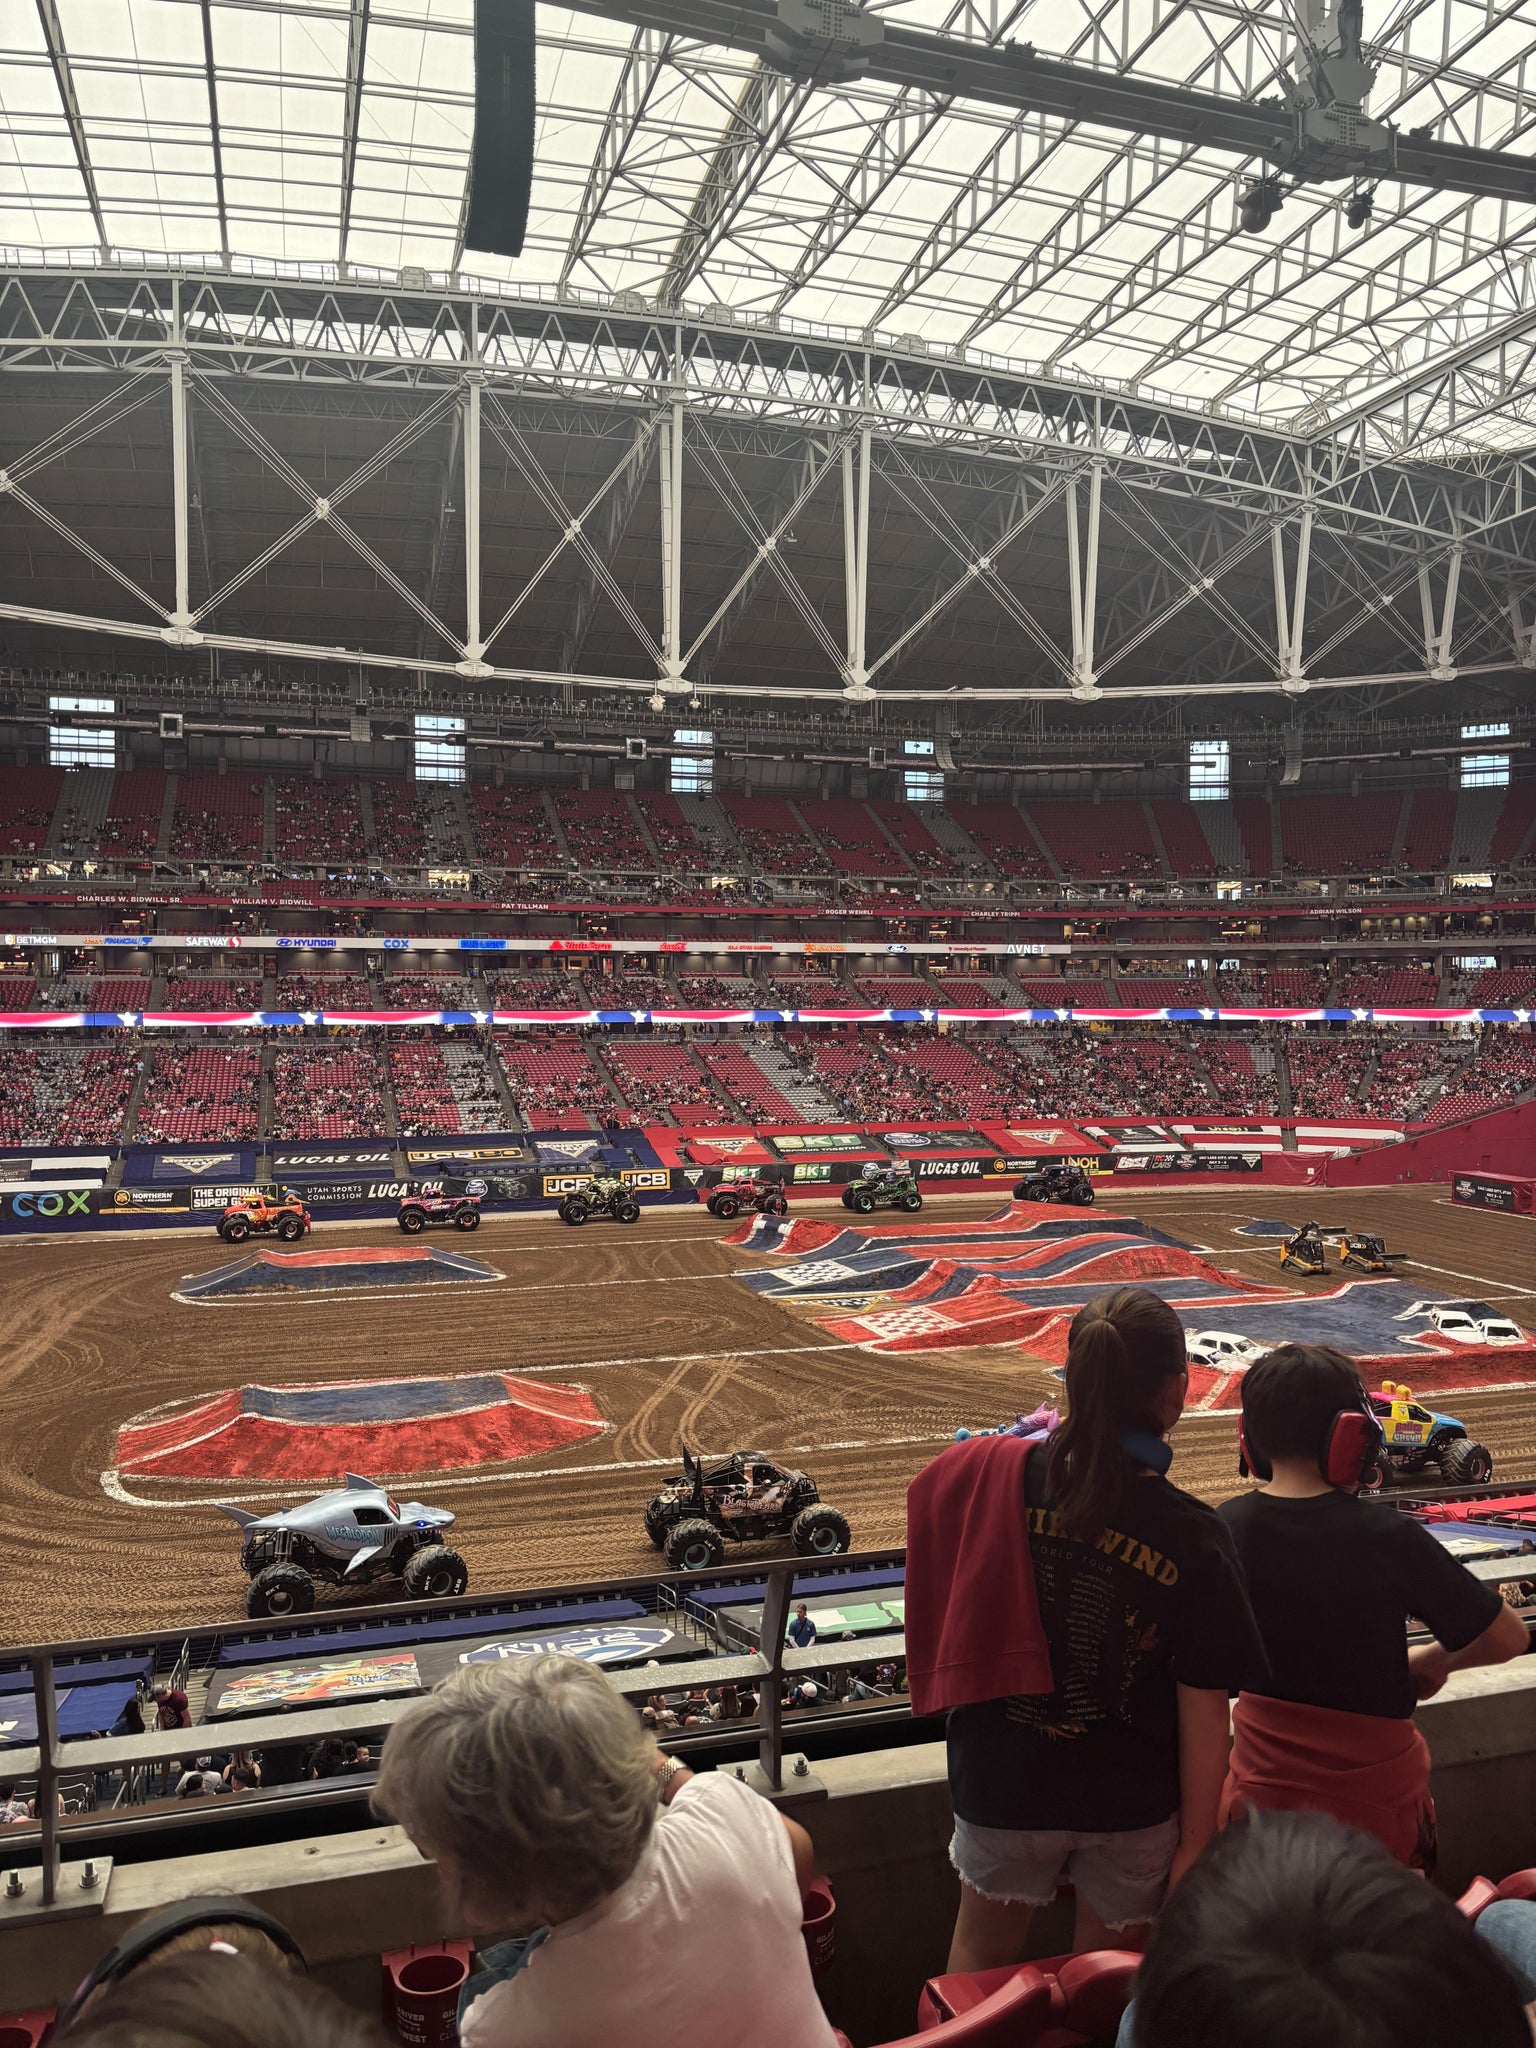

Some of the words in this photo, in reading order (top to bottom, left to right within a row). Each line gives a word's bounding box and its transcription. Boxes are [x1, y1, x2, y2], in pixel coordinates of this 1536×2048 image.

[130, 896, 168, 904] BIDWILL,
[185, 937, 230, 946] SAFEWAY
[293, 939, 337, 947] HYUNDAI
[383, 939, 409, 949] COX
[1007, 944, 1047, 954] AVNET
[776, 1135, 857, 1146] BKT
[274, 1154, 350, 1165] LUCAS
[1152, 1161, 1173, 1169] CARS
[795, 1165, 831, 1177] BKT
[919, 1163, 959, 1176] LUCAS
[960, 1162, 980, 1175] OIL
[625, 1173, 667, 1187] JCB
[132, 1192, 173, 1200] NORTHERN
[193, 1188, 214, 1198] THE
[307, 1192, 361, 1201] COMMISSION
[12, 1190, 91, 1217] COX
[193, 1197, 228, 1208] SUPER
[324, 1524, 382, 1545] MEGALODON
[808, 1527, 818, 1542] BKT
[424, 1575, 432, 1591] BKT
[453, 1578, 462, 1594] BKT
[265, 1584, 281, 1597] BKT
[402, 2031, 428, 2044] WEST
